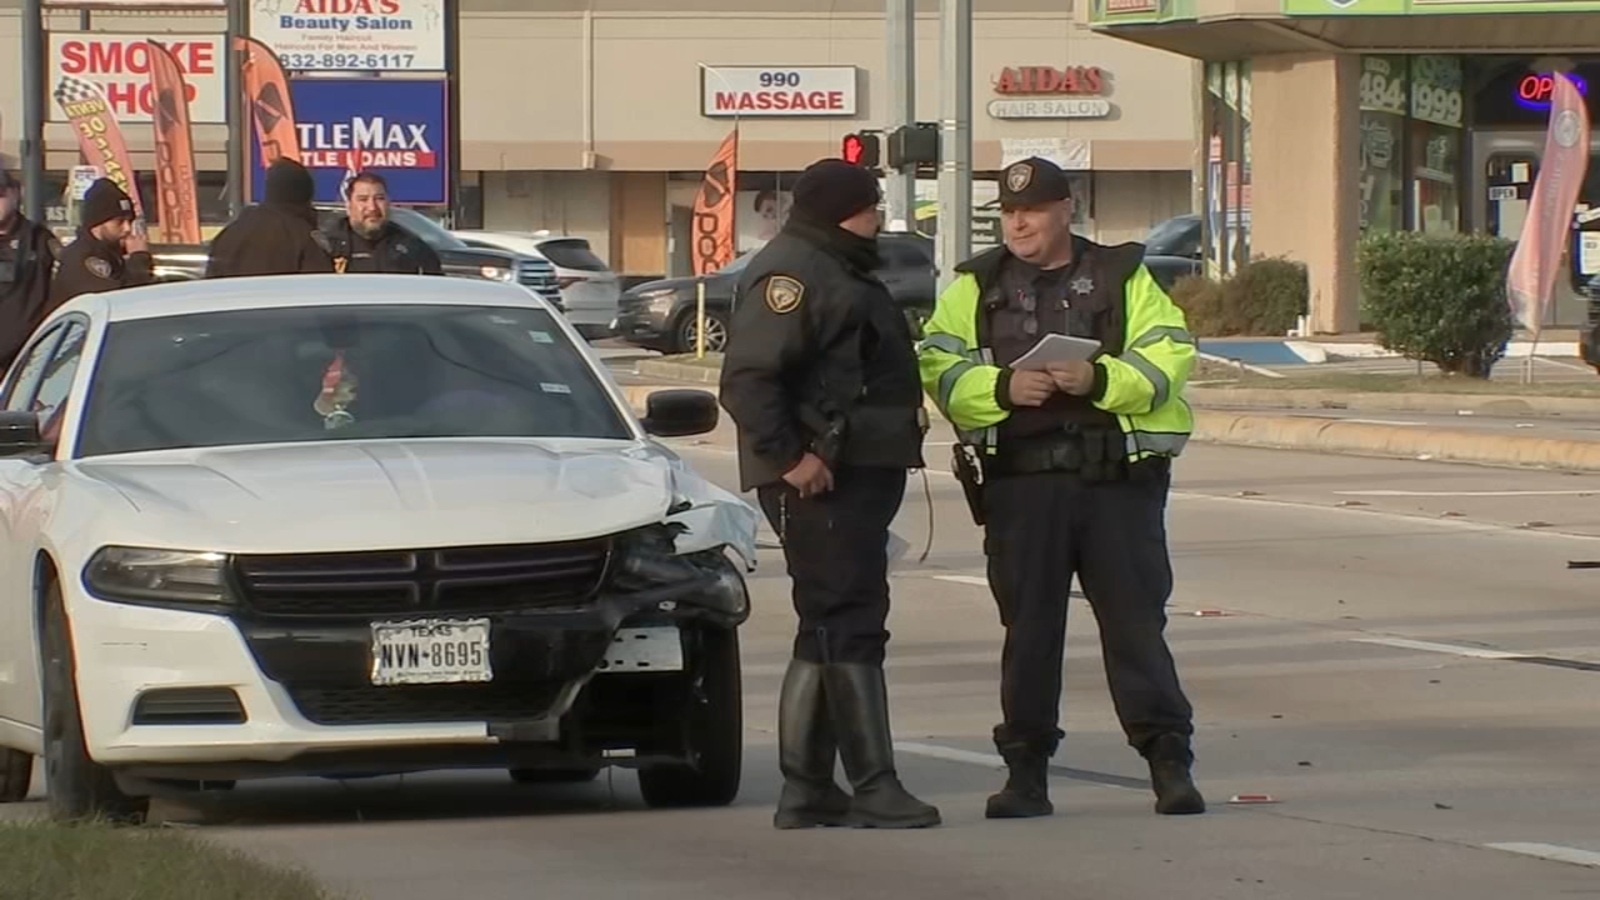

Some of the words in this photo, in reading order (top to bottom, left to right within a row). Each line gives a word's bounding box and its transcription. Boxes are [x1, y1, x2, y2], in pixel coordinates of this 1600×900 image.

[279, 15, 351, 32] Beauty
[355, 15, 413, 29] Salon
[301, 33, 333, 43] Family
[318, 43, 334, 51] For
[360, 43, 380, 51] And
[279, 53, 415, 68] 832-892-6117
[759, 71, 801, 88] 990
[994, 66, 1105, 95] AIDA'S
[715, 91, 844, 110] MASSAGE
[996, 101, 1037, 116] HAIR
[411, 625, 453, 638] TEXAS
